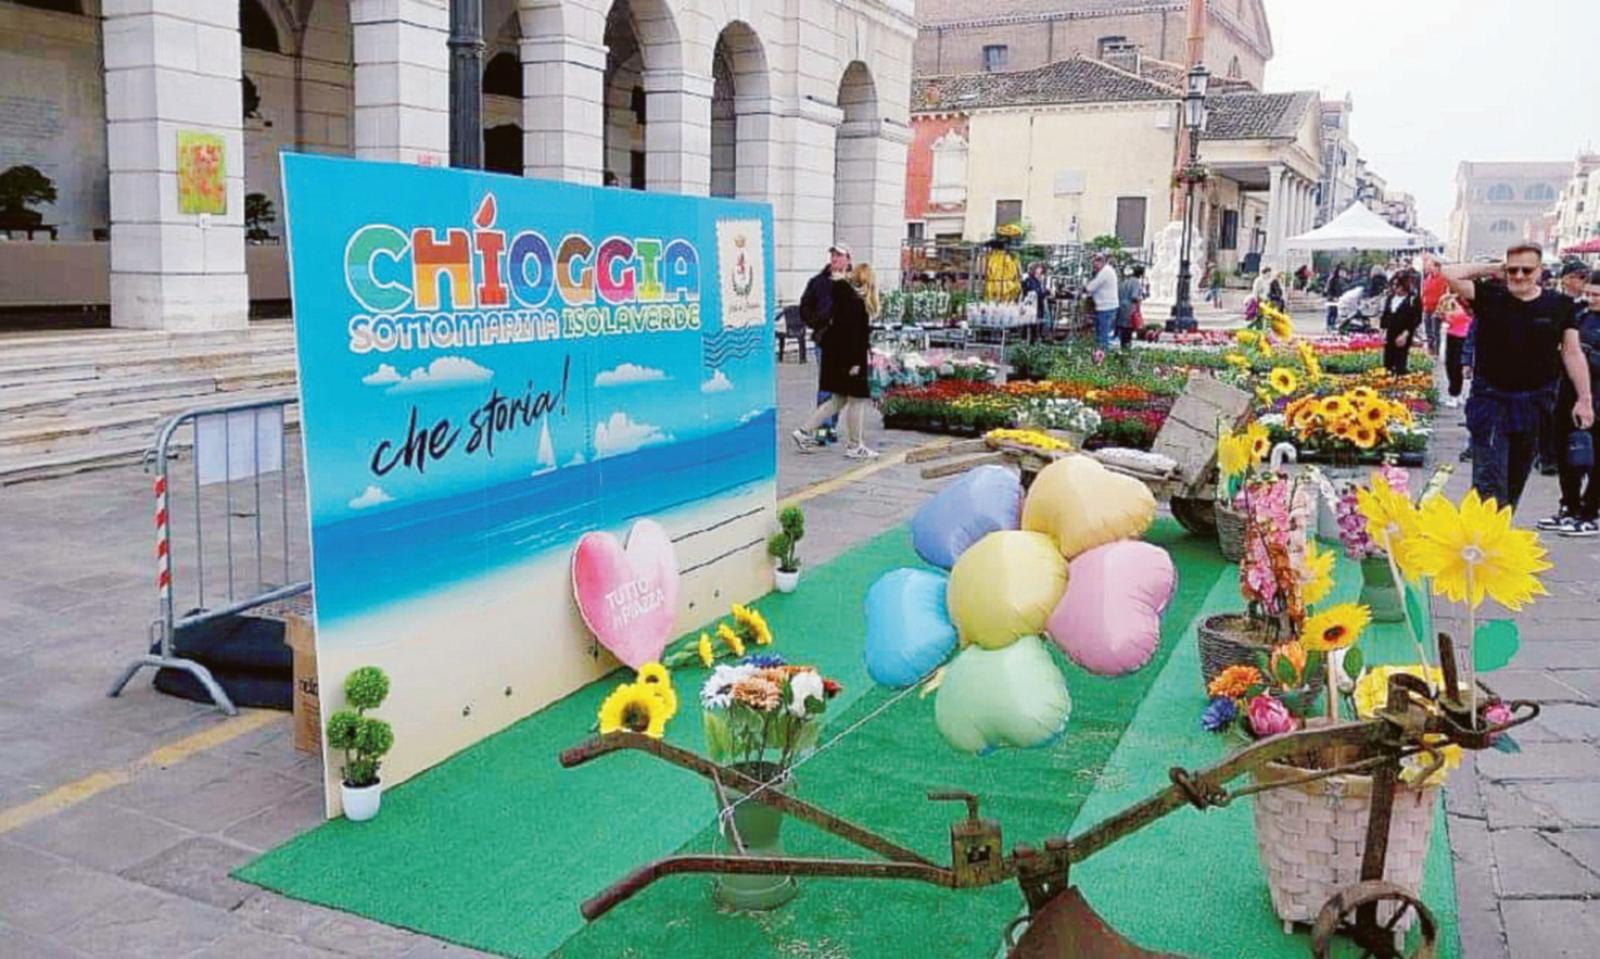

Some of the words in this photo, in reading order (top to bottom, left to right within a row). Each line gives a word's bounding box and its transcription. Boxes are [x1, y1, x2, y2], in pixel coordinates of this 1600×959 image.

[350, 312, 559, 353] SOTTOMARINA
[561, 303, 701, 339] ISOLAVERDE
[371, 404, 461, 476] che
[465, 354, 570, 459] storia!
[605, 579, 649, 610] TUTTO
